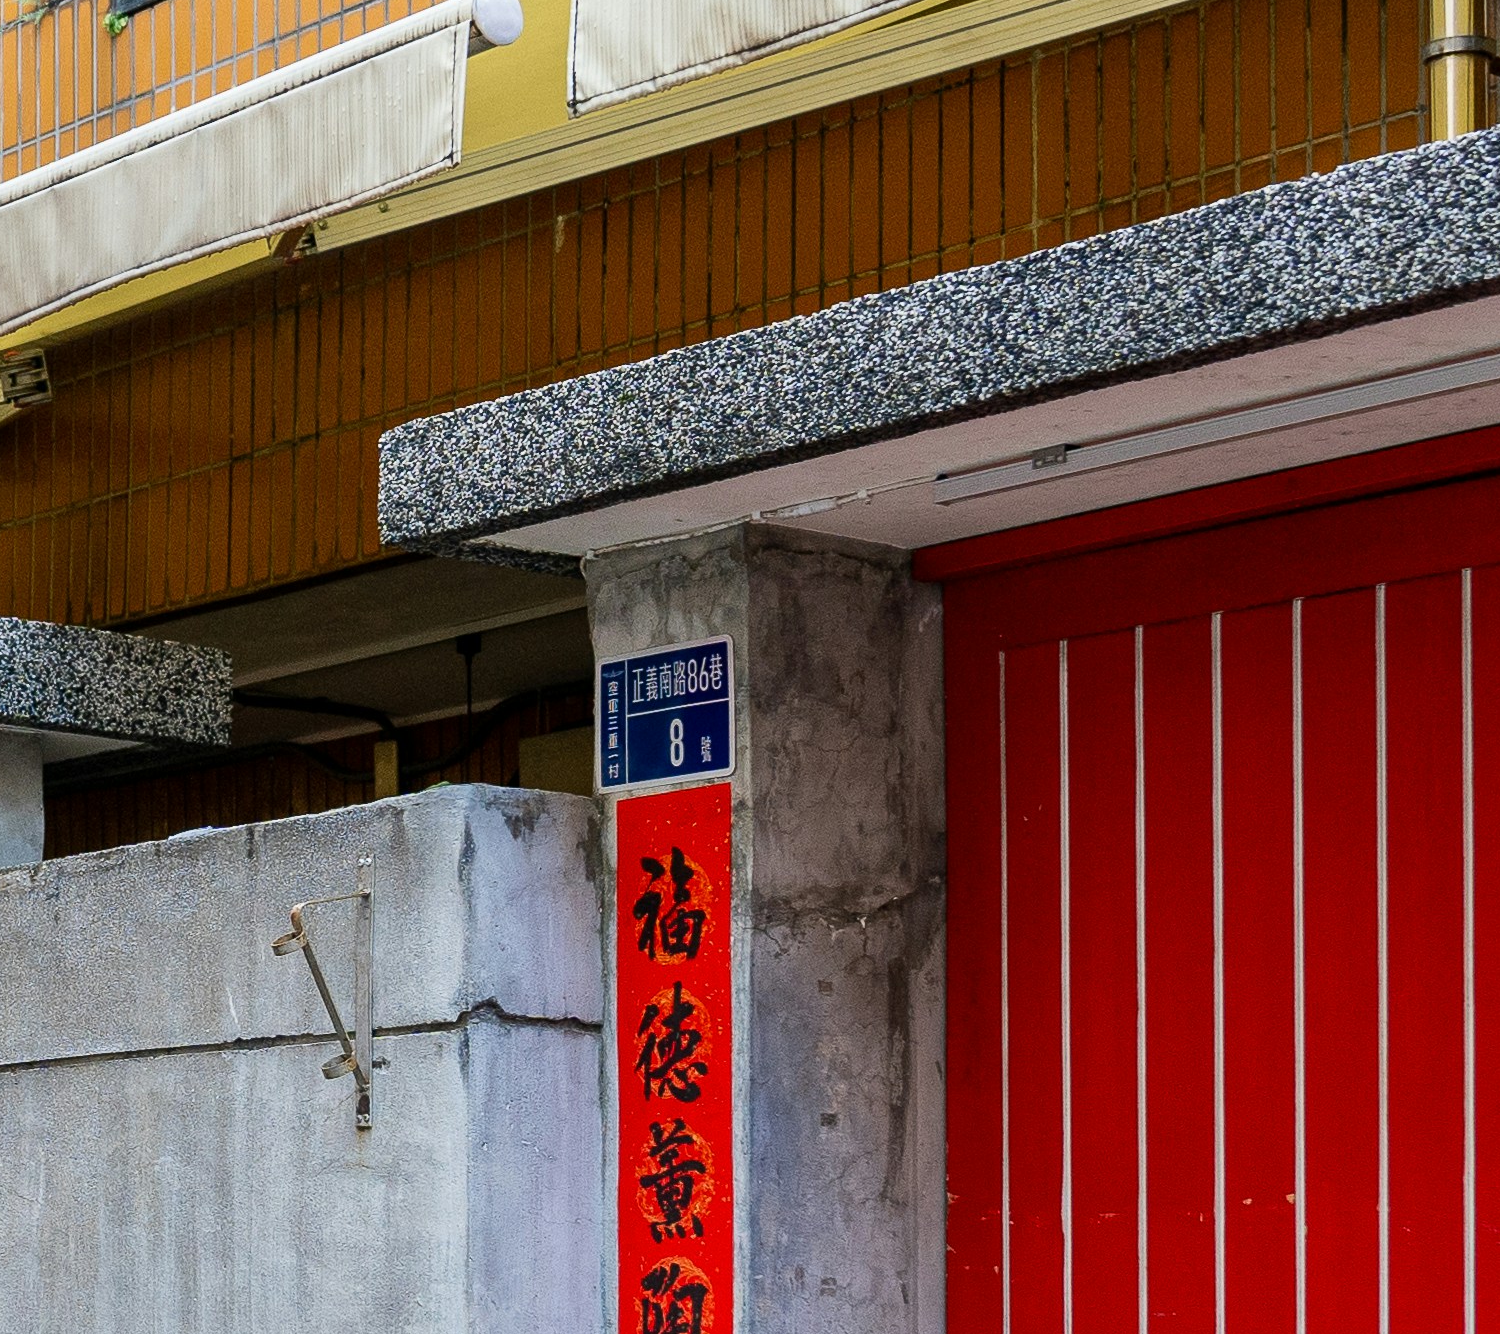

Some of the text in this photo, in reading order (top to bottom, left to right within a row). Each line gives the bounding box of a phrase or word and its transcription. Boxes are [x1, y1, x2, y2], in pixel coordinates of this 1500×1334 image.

[631, 653, 723, 704] 正義南路86巷
[670, 718, 712, 767] 8 號
